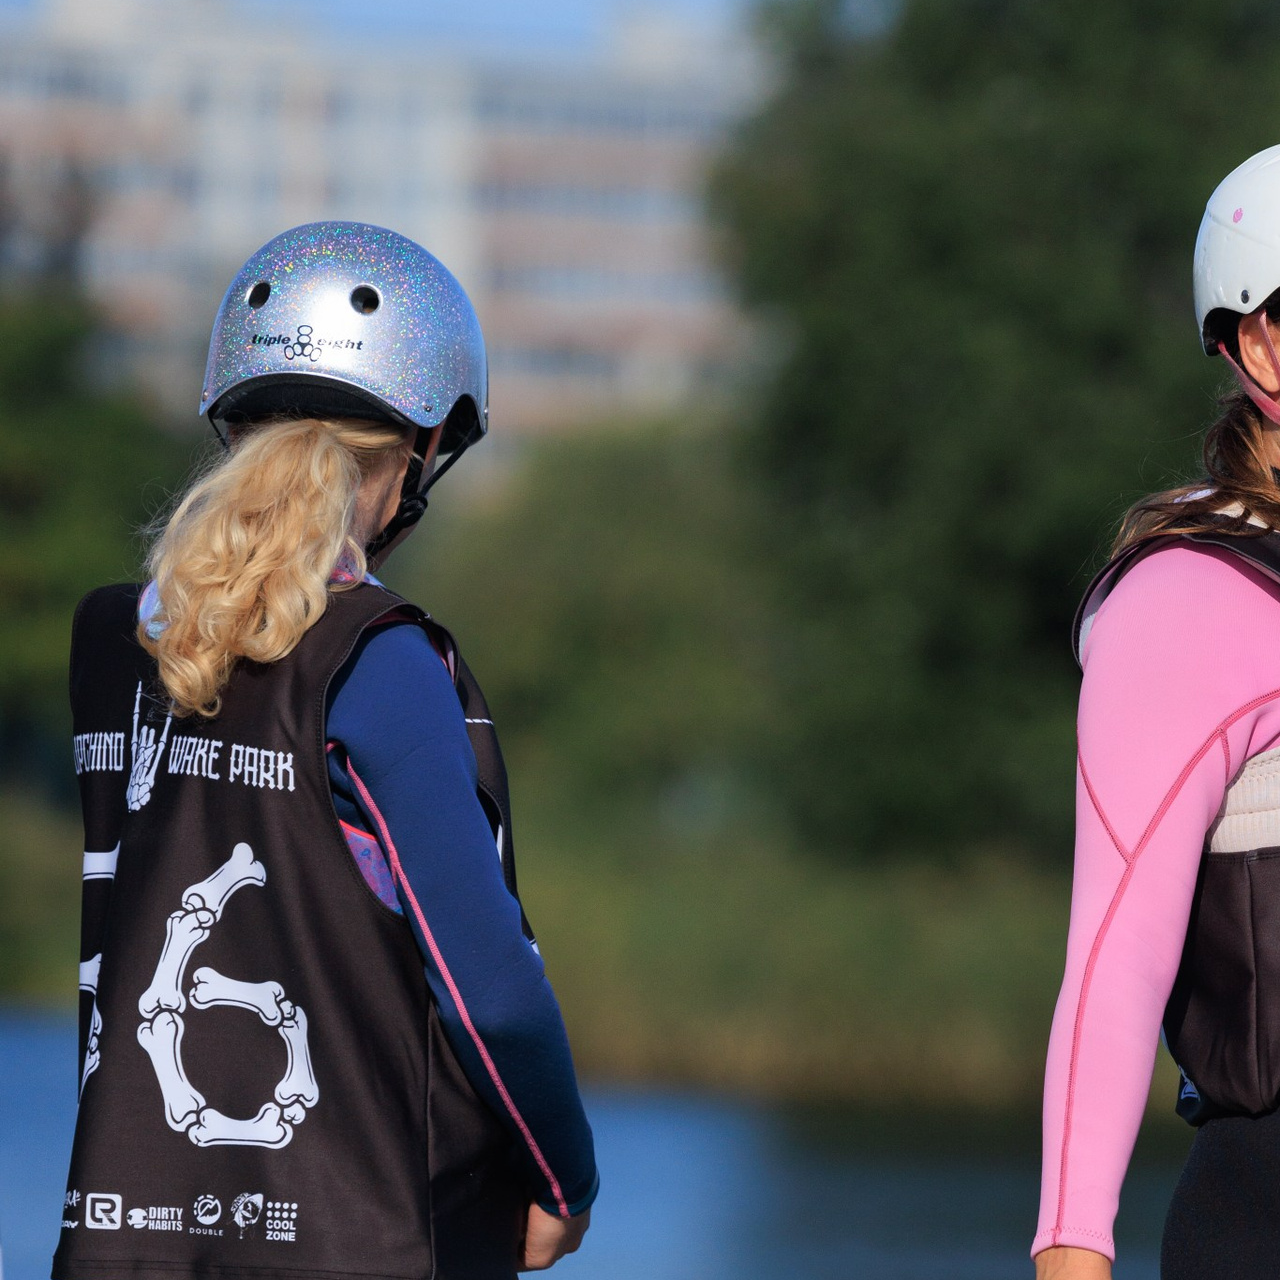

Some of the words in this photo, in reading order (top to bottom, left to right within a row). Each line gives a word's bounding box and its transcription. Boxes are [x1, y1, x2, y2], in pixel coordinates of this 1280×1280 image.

[252, 333, 291, 346] triple
[168, 735, 223, 780] WAKE
[228, 743, 296, 792] PARK
[148, 1207, 183, 1220] DIRTY
[148, 1220, 183, 1231] HABITS
[266, 1219, 296, 1230] COOL
[189, 1227, 224, 1236] DOUBLE
[266, 1231, 296, 1241] ZONE
